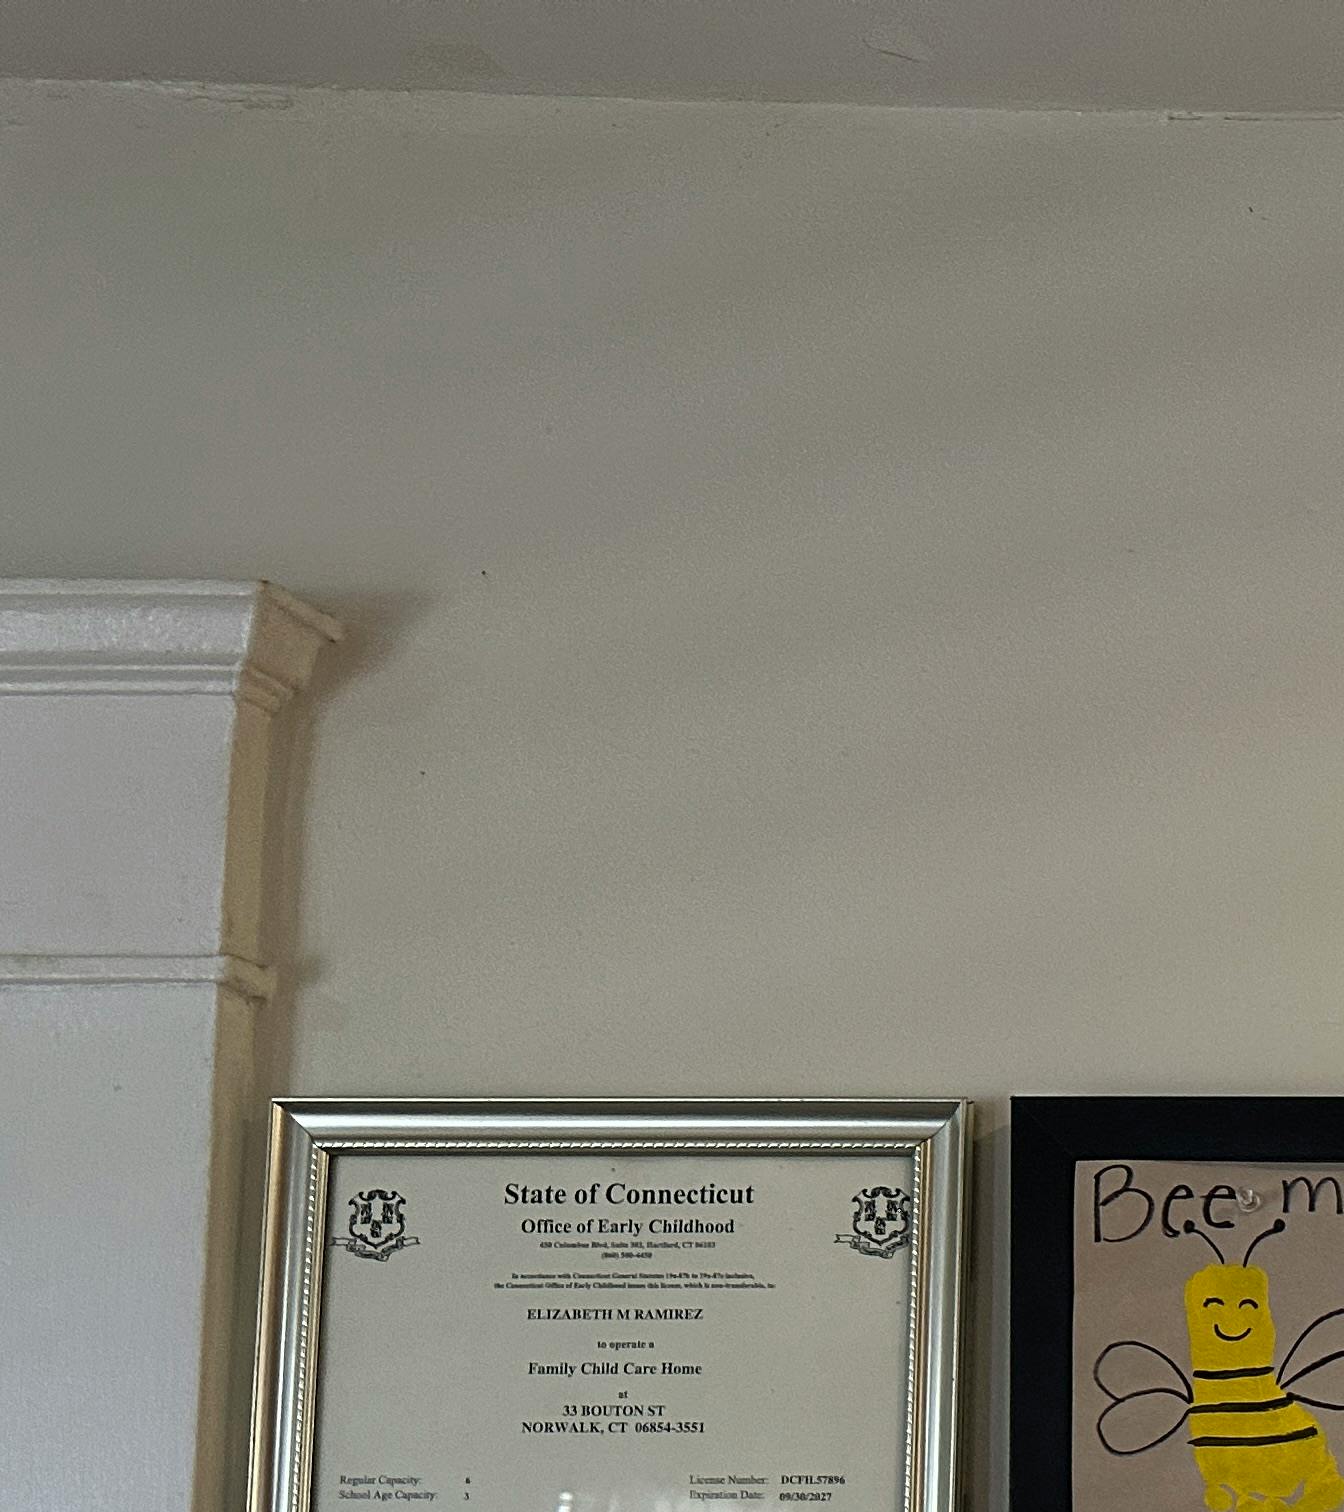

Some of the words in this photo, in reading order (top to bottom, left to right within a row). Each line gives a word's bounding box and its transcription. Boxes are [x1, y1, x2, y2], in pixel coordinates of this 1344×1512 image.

[504, 1182, 567, 1205] State
[574, 1182, 601, 1205] of
[605, 1182, 755, 1205] Connecticut
[1094, 1164, 1236, 1245] Bee
[521, 1218, 572, 1234] Office
[576, 1218, 595, 1234] of
[597, 1218, 644, 1238] Early
[648, 1218, 735, 1234] Childhood
[527, 1308, 613, 1321] ELIZABETH
[616, 1308, 630, 1321] M
[634, 1308, 704, 1320] RAMIREZ
[528, 1361, 577, 1378] Family
[580, 1361, 619, 1376] Child
[623, 1362, 657, 1375] Care
[661, 1362, 703, 1375] Home
[562, 1404, 578, 1417] 33
[581, 1404, 644, 1417] BOUTON
[647, 1405, 666, 1417] ST
[521, 1421, 605, 1435] NORWALK,
[607, 1421, 629, 1434] CT
[634, 1421, 705, 1434] 06854-3551
[689, 1474, 726, 1485] License
[727, 1474, 769, 1485] Number:
[689, 1489, 739, 1502] Expiration
